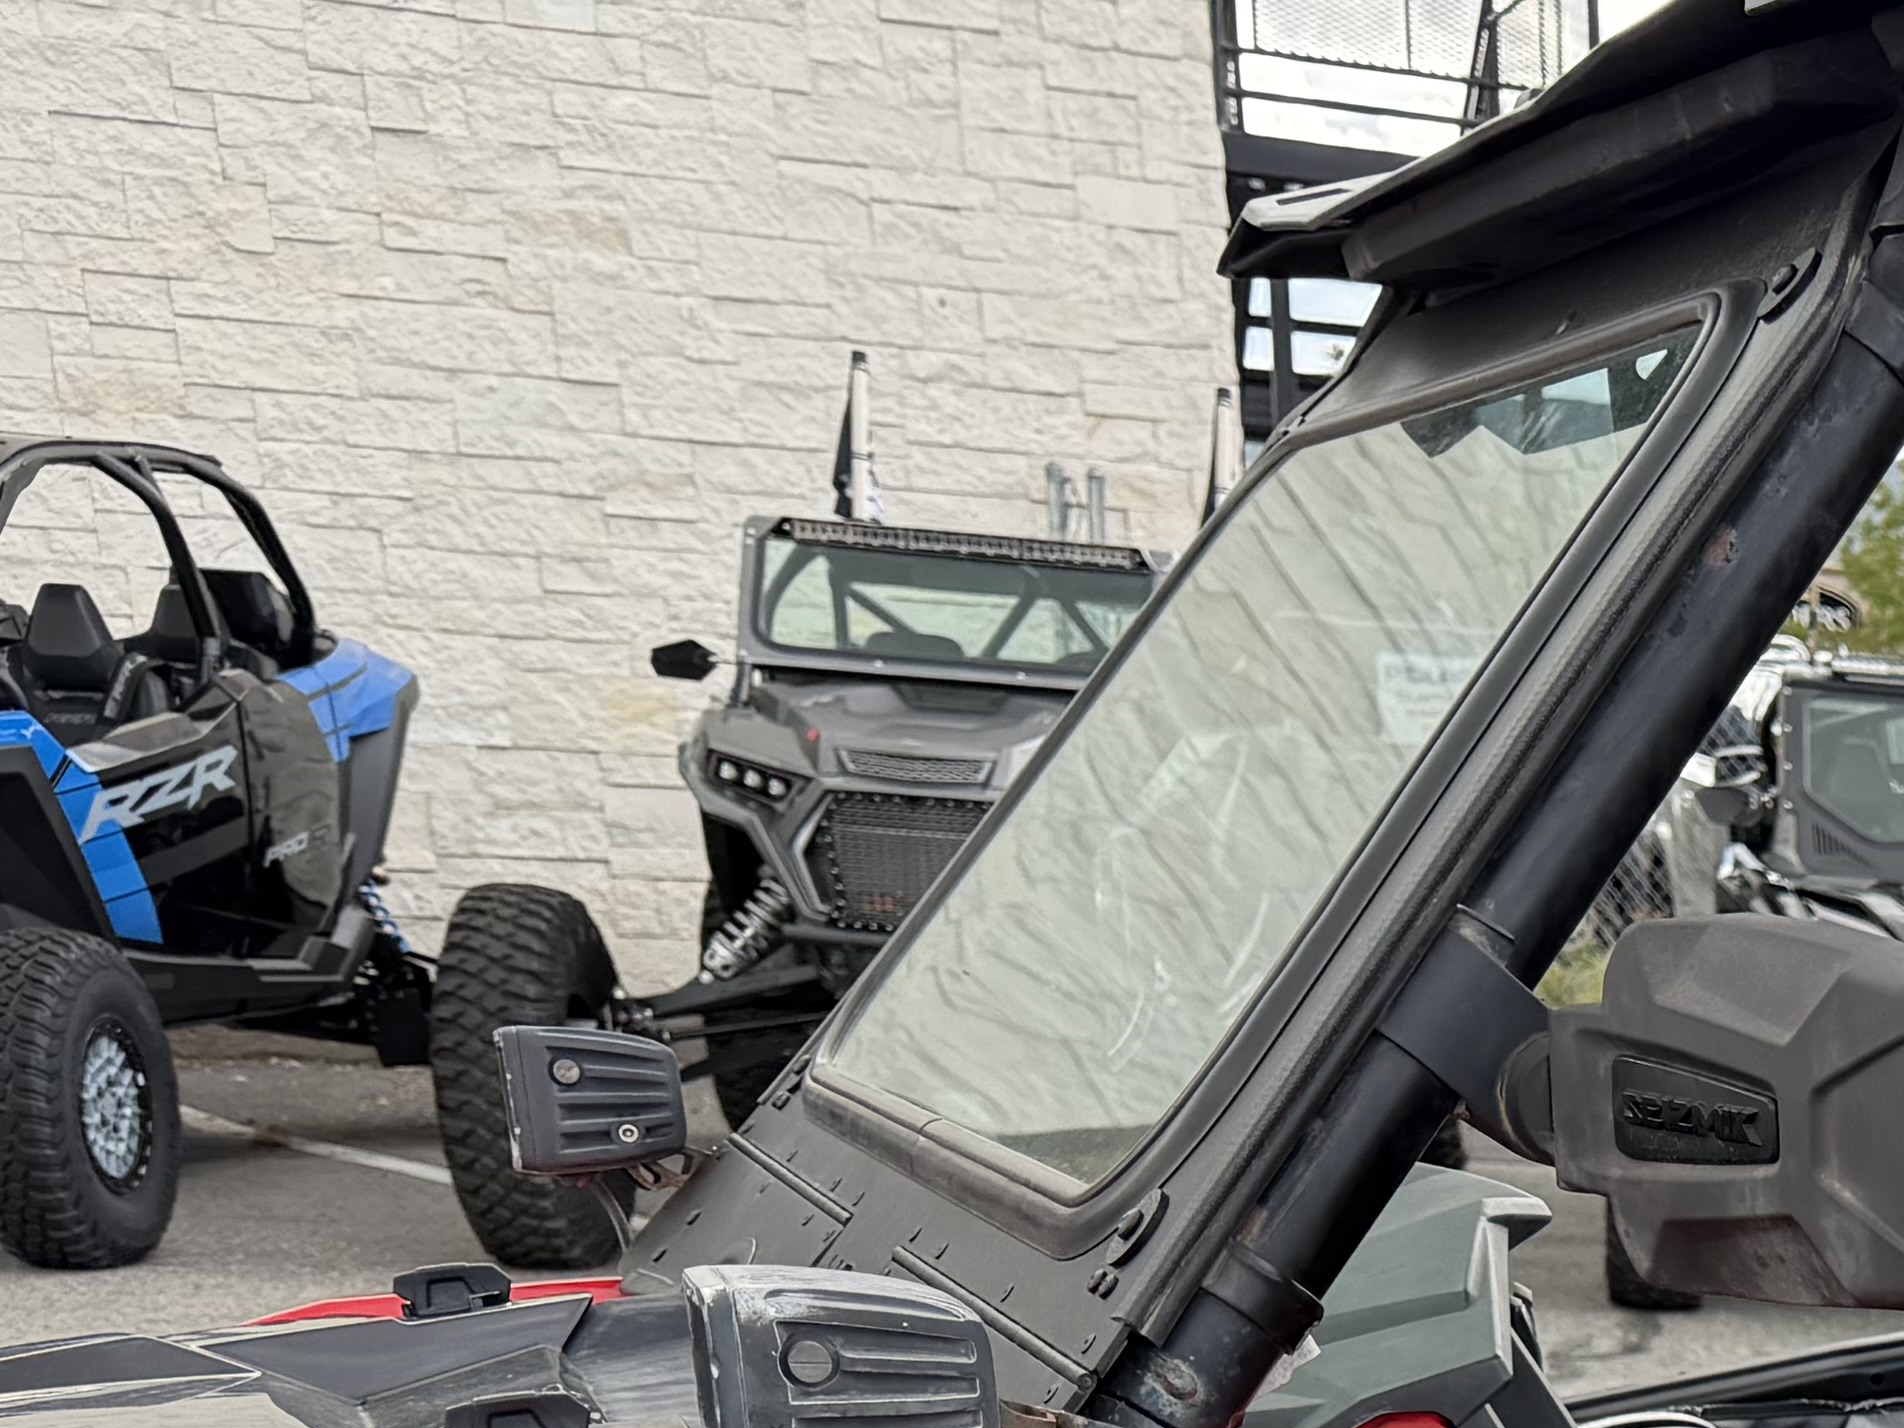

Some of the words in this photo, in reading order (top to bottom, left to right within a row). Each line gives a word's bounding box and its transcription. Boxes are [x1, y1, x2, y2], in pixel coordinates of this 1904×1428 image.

[79, 745, 238, 846] RZR
[263, 831, 310, 868] PRO
[1622, 1088, 1763, 1148] SEIZMIK
